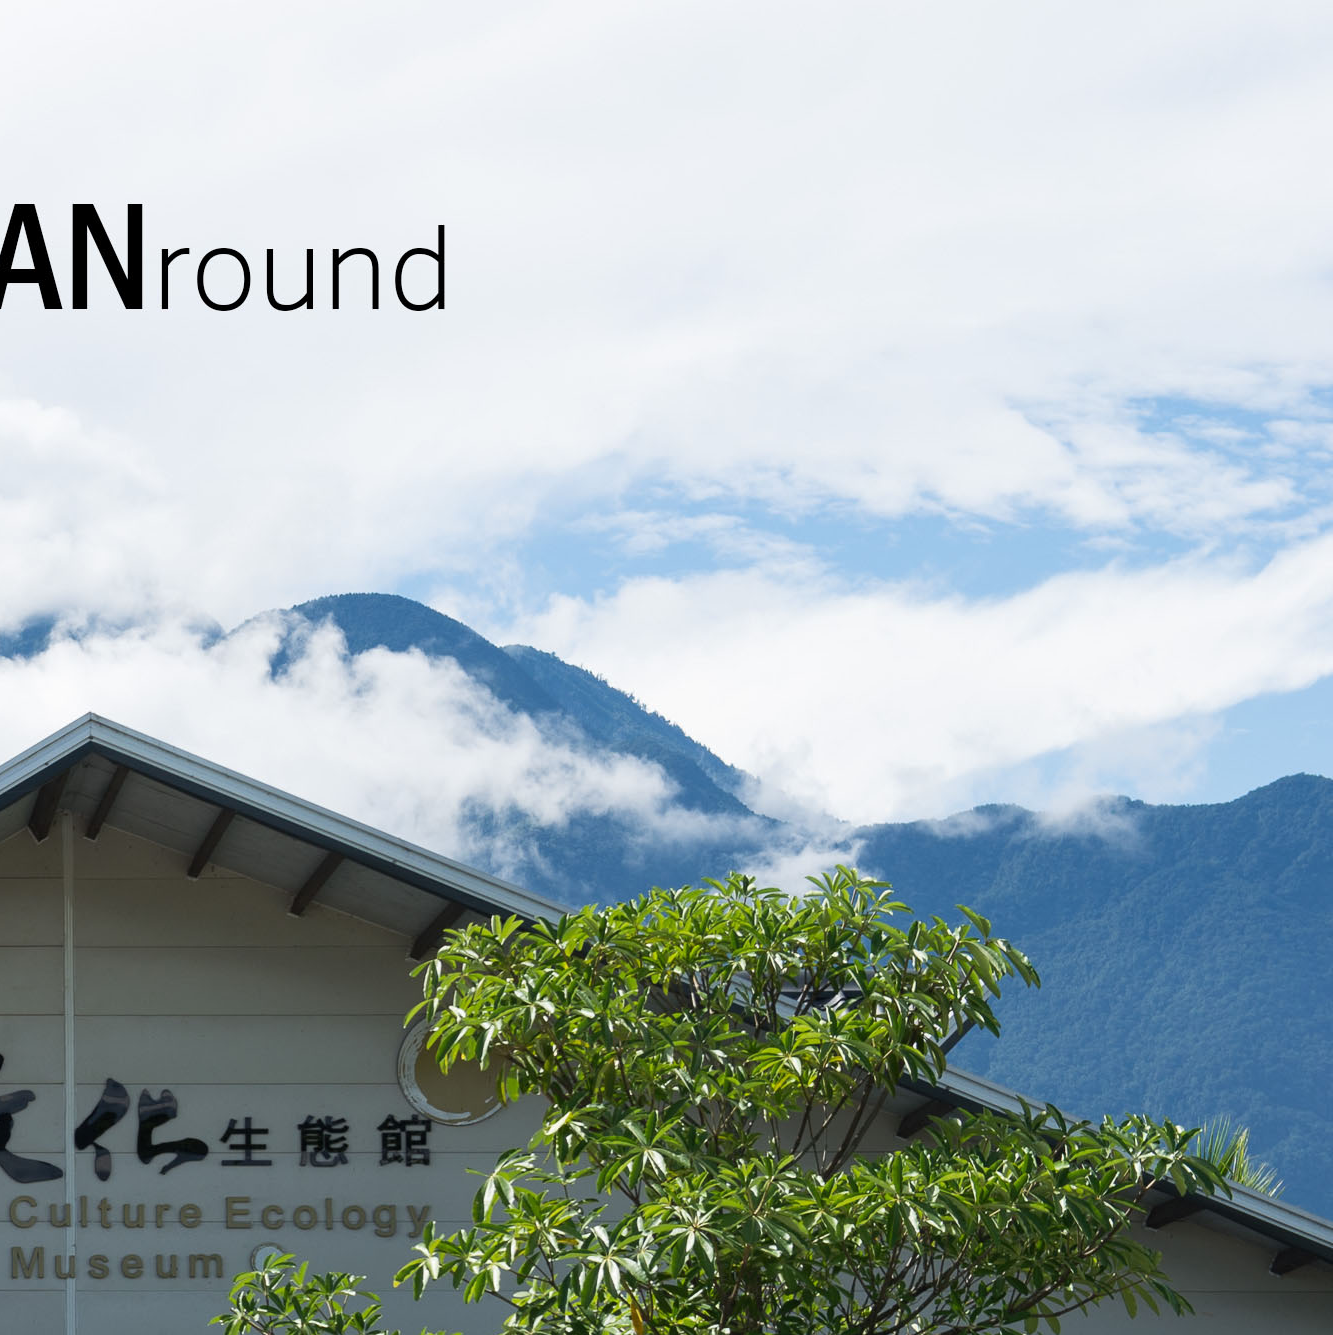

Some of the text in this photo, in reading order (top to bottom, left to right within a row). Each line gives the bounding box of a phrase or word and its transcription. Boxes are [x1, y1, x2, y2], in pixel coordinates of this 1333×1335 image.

[9, 1195, 432, 1238] Culture Ecology
[11, 1246, 224, 1280] Museum
